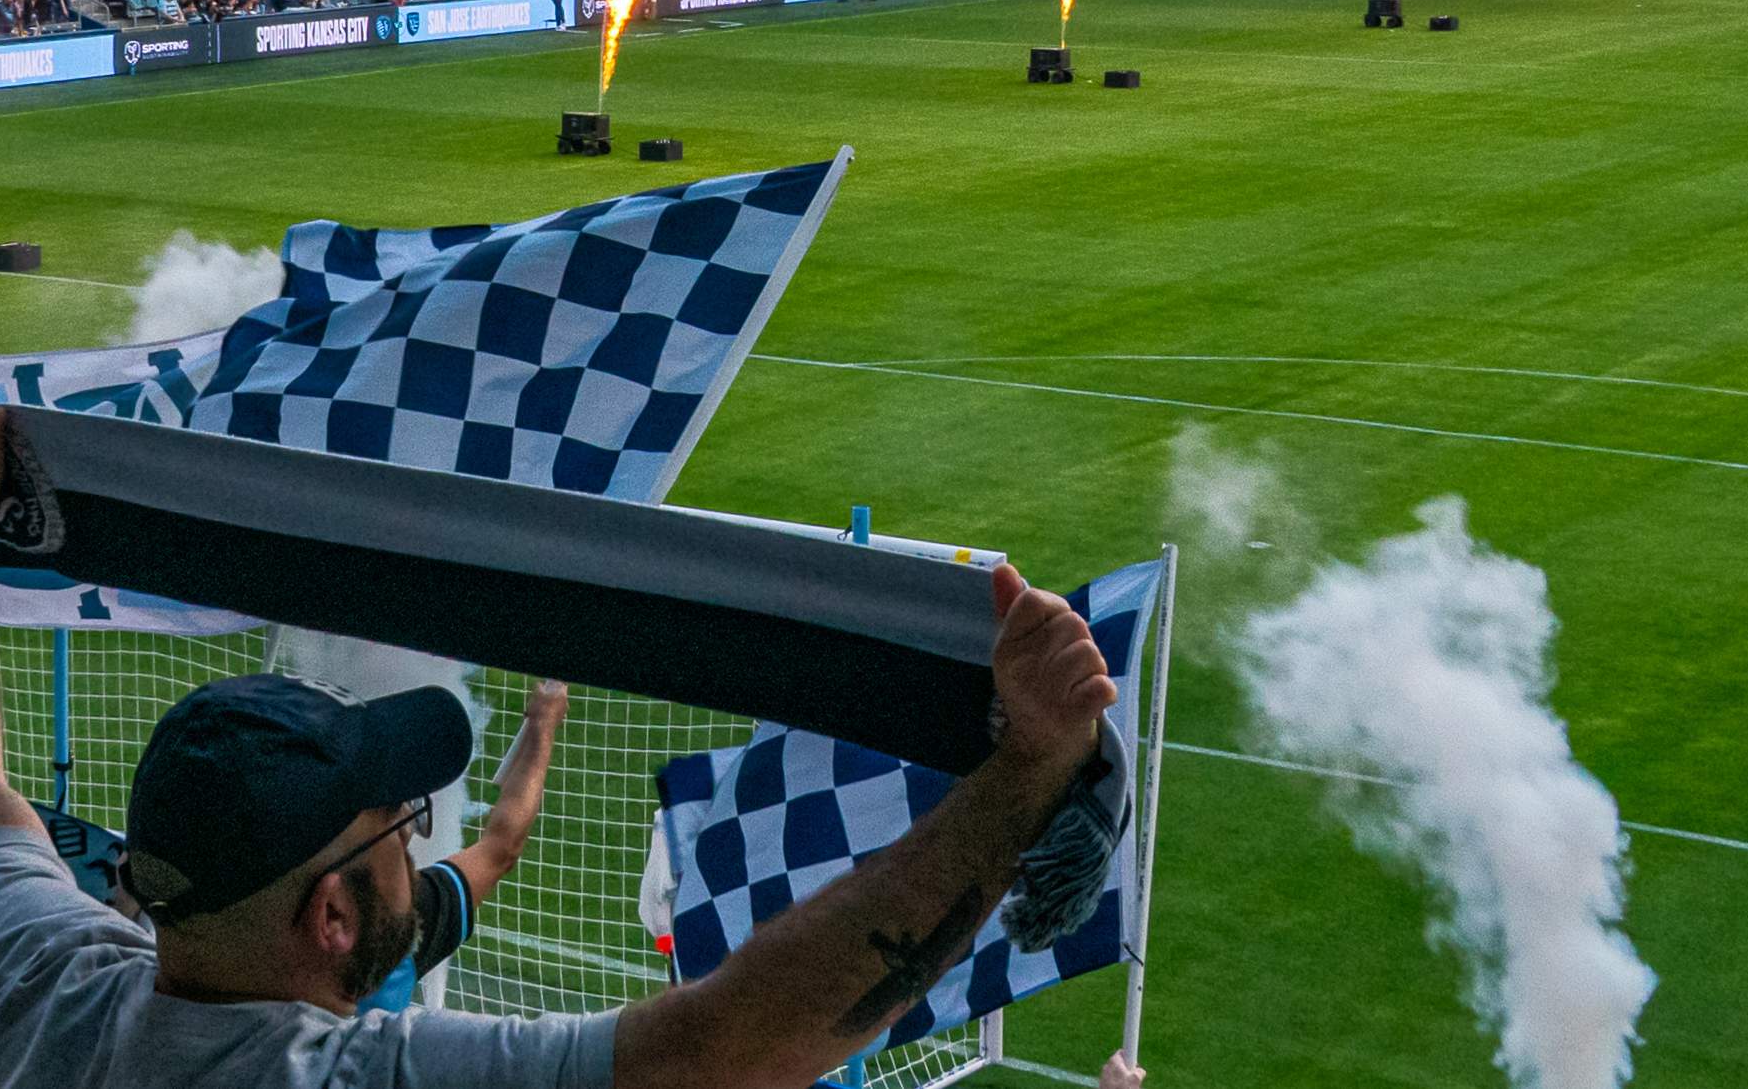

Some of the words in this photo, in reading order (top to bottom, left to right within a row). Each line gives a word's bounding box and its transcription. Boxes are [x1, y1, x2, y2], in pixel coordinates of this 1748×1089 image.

[256, 22, 306, 52] SPORTING
[306, 18, 347, 47] KANSAS
[348, 15, 370, 44] CITY
[427, 12, 448, 34] SAN
[449, 8, 470, 32] JOSE
[471, 2, 531, 29] EARTHQUAKES
[141, 39, 189, 54] SPORTING
